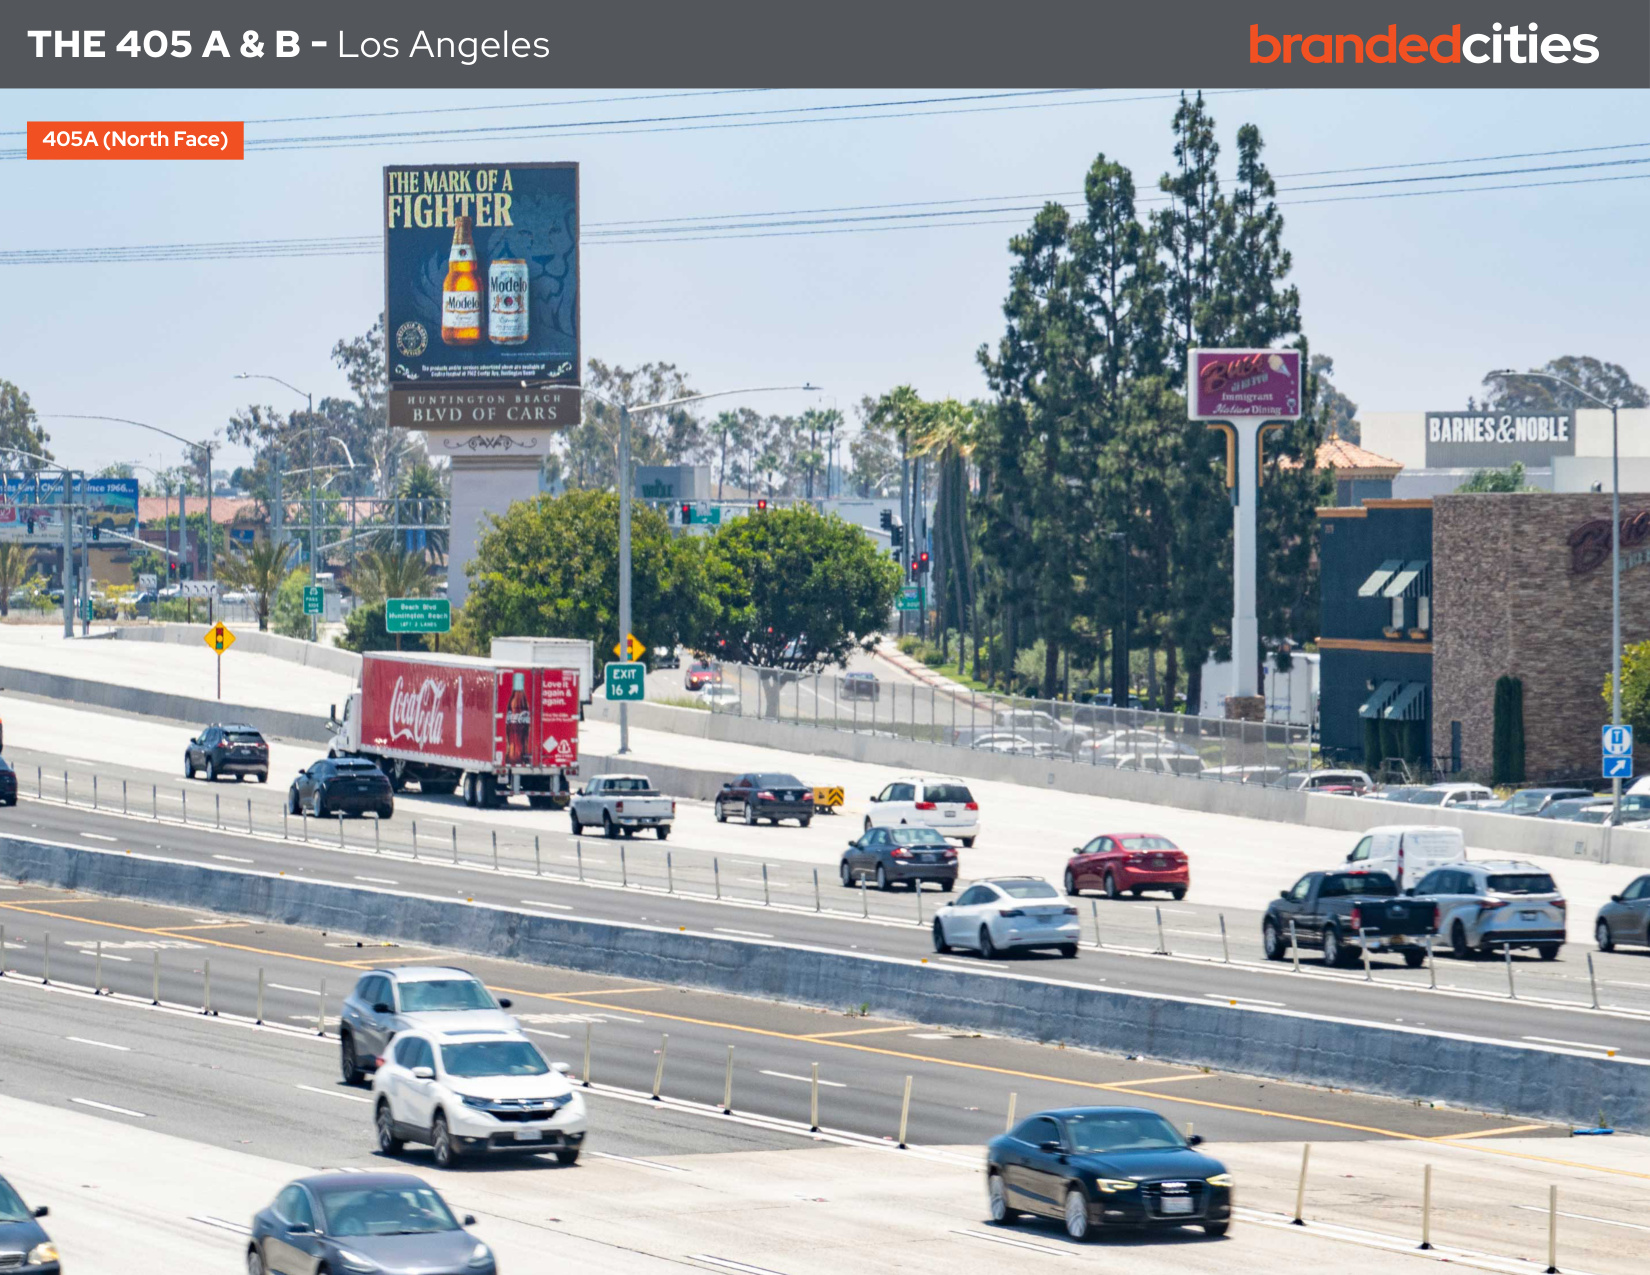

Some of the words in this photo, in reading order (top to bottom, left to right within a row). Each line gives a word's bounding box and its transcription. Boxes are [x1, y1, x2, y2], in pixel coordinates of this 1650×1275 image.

[388, 171, 419, 193] THE
[423, 170, 472, 192] MARK
[476, 169, 498, 192] OF
[502, 169, 513, 191] A
[388, 193, 514, 229] FIGHTER
[490, 276, 527, 293] Modelo
[448, 296, 479, 310] Modelo
[408, 395, 505, 405] HUNTINGTON
[515, 394, 561, 403] BEACH
[1222, 392, 1274, 403] Immigrant
[413, 407, 463, 422] BLVD
[472, 407, 496, 420] OF
[506, 406, 557, 420] CARS
[1251, 405, 1282, 416] Dining
[388, 612, 424, 620] Huntington
[613, 669, 636, 679] EXIT
[563, 680, 569, 688] it
[542, 689, 565, 698] again
[565, 689, 572, 697] &
[612, 684, 624, 696] 16
[542, 698, 567, 707] again.
